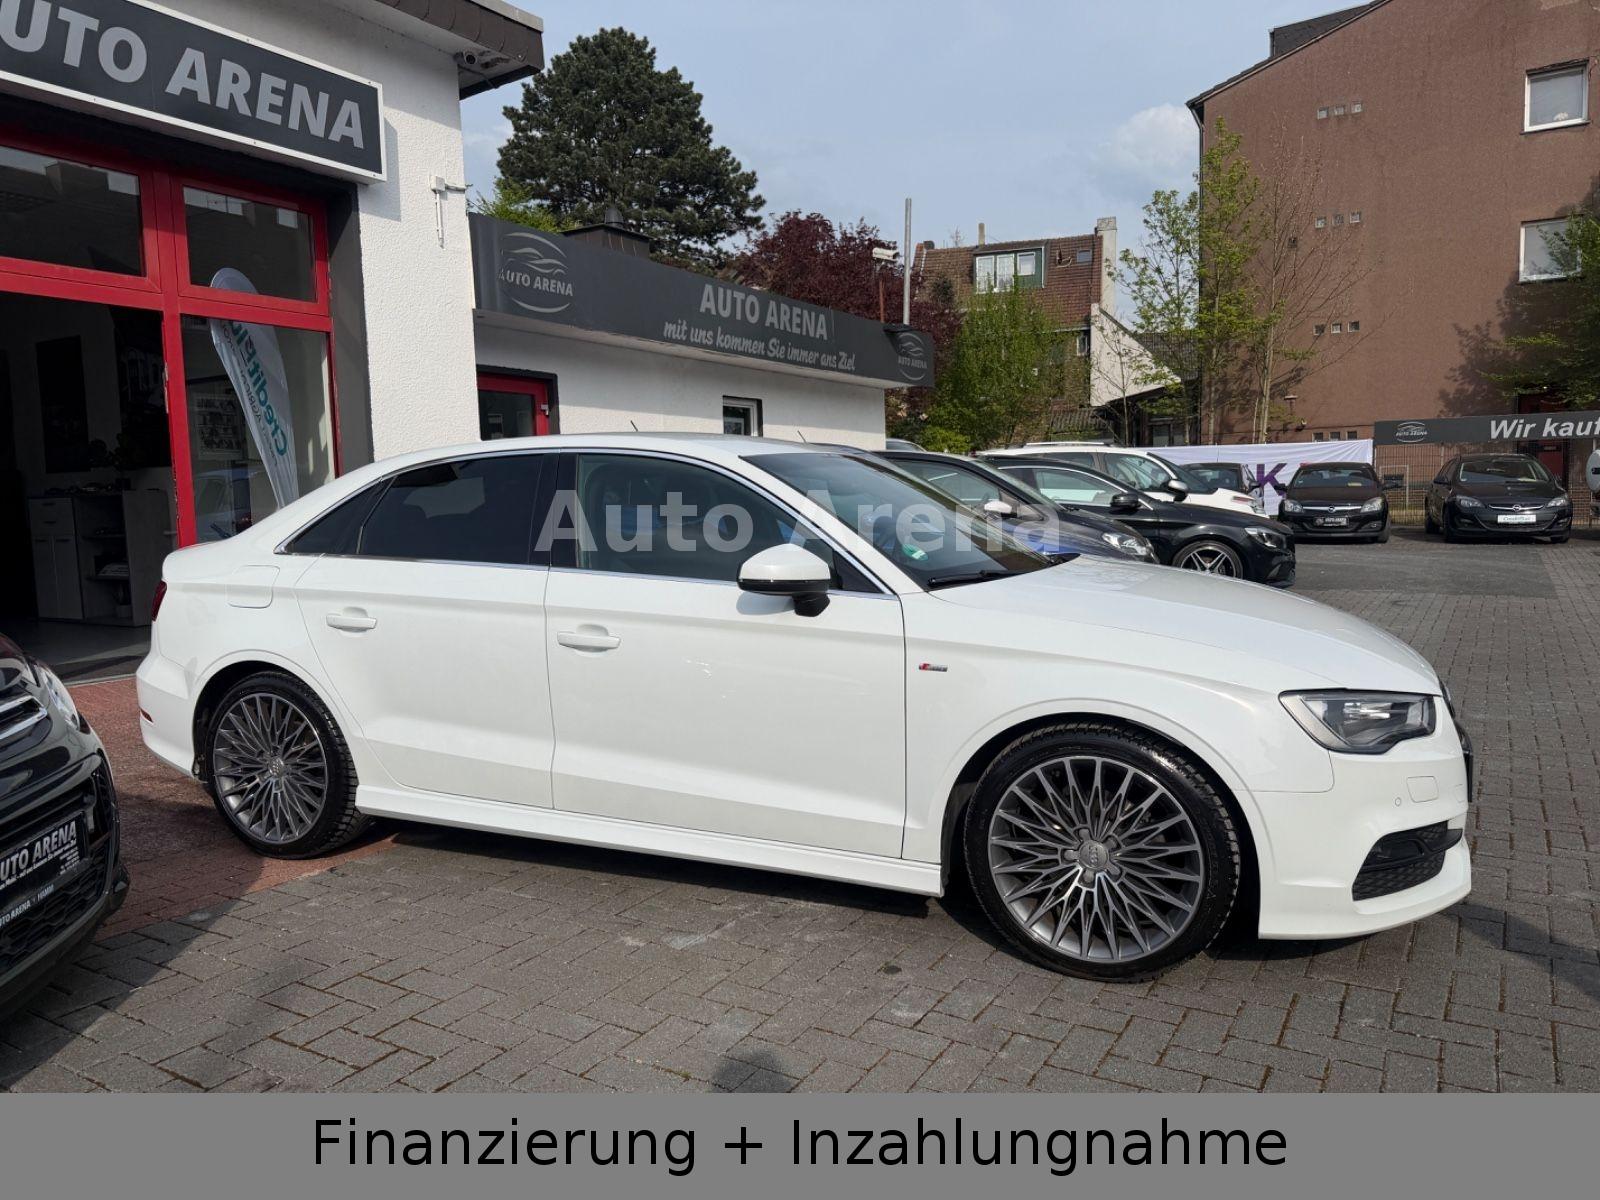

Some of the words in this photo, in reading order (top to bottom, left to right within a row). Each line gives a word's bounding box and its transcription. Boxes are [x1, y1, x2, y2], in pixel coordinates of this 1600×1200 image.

[0, 0, 148, 84] UTO
[165, 47, 365, 150] ARENA
[497, 268, 531, 288] AUTO
[533, 276, 574, 297] ARENA
[700, 283, 761, 325] AUTO
[764, 300, 829, 341] ARENA
[663, 318, 688, 341] mit
[690, 327, 714, 345] uns
[716, 326, 766, 356] kommen
[767, 337, 786, 359] Sie
[787, 341, 821, 364] immer
[820, 352, 837, 368] ans
[838, 351, 856, 371] Ziel
[1490, 418, 1537, 440] Wir
[0, 850, 29, 881] UTO
[32, 821, 77, 864] ARENA
